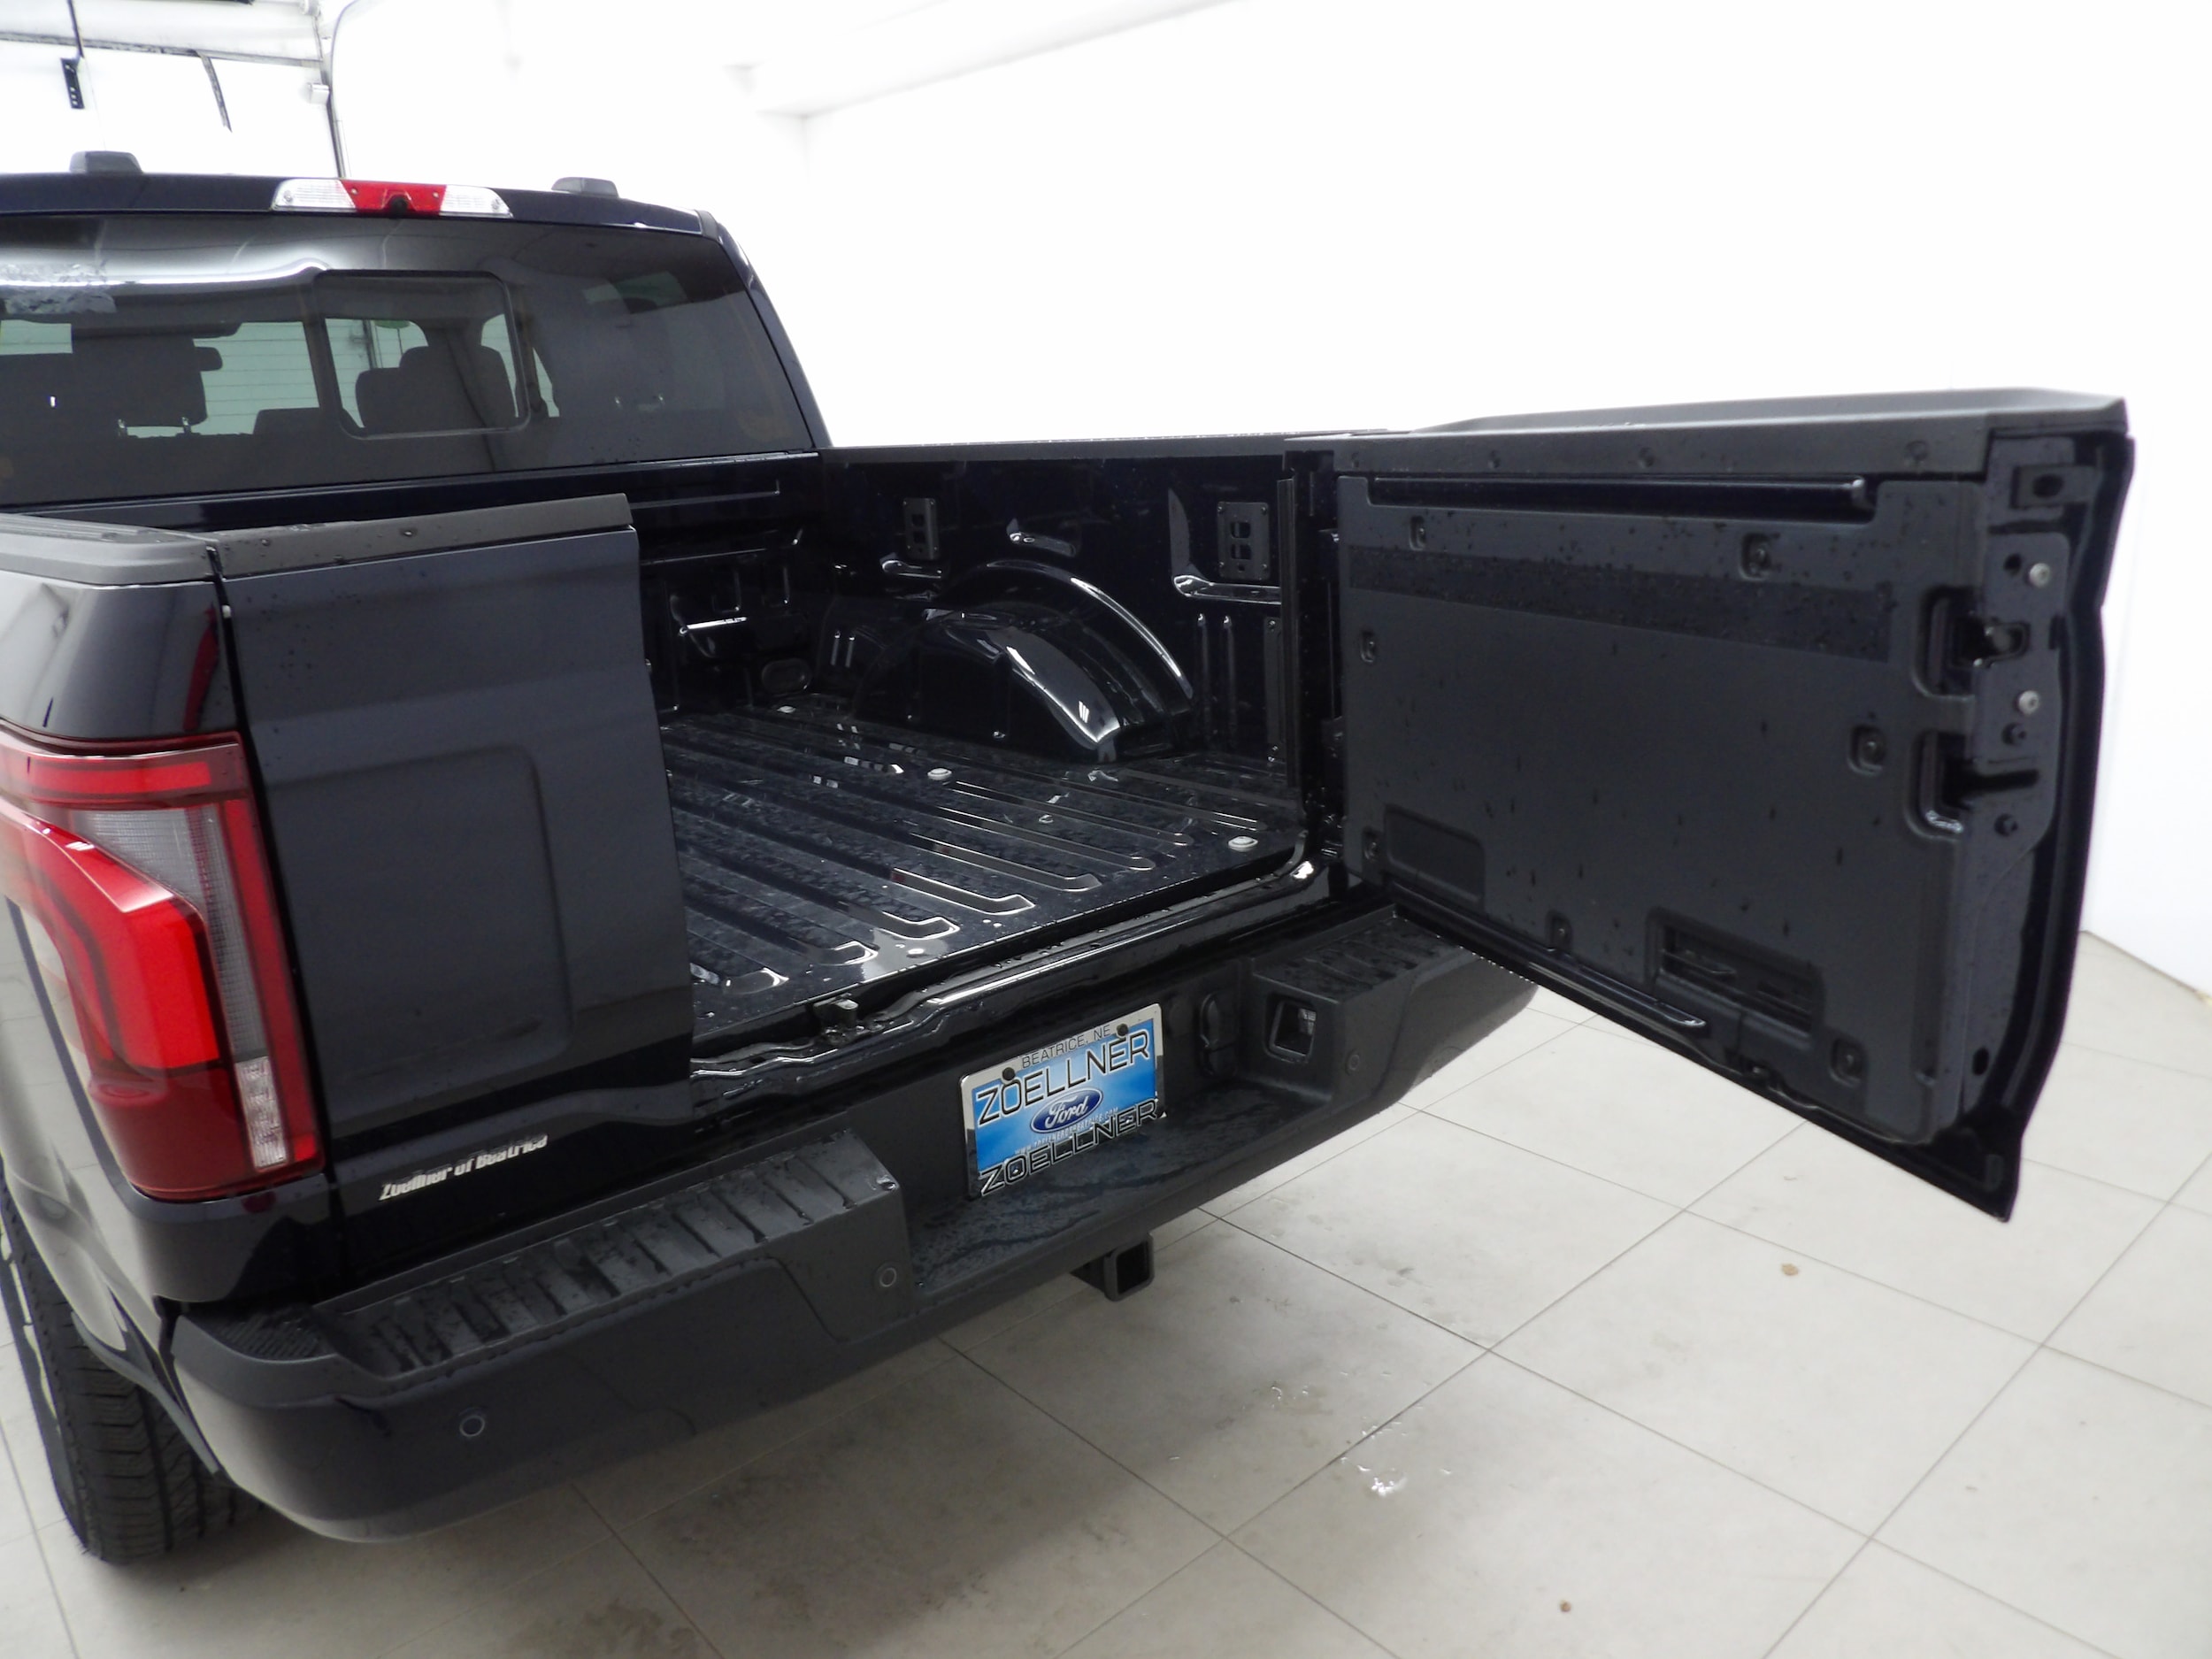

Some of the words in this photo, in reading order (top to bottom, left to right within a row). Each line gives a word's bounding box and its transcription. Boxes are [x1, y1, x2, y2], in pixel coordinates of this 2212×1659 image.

[976, 1028, 1150, 1126] ZOELLNER
[1021, 1035, 1089, 1069] BEATRICE,
[1094, 1025, 1111, 1041] NE
[980, 1098, 1158, 1196] ZOELLNER
[1044, 1095, 1089, 1129] Ford
